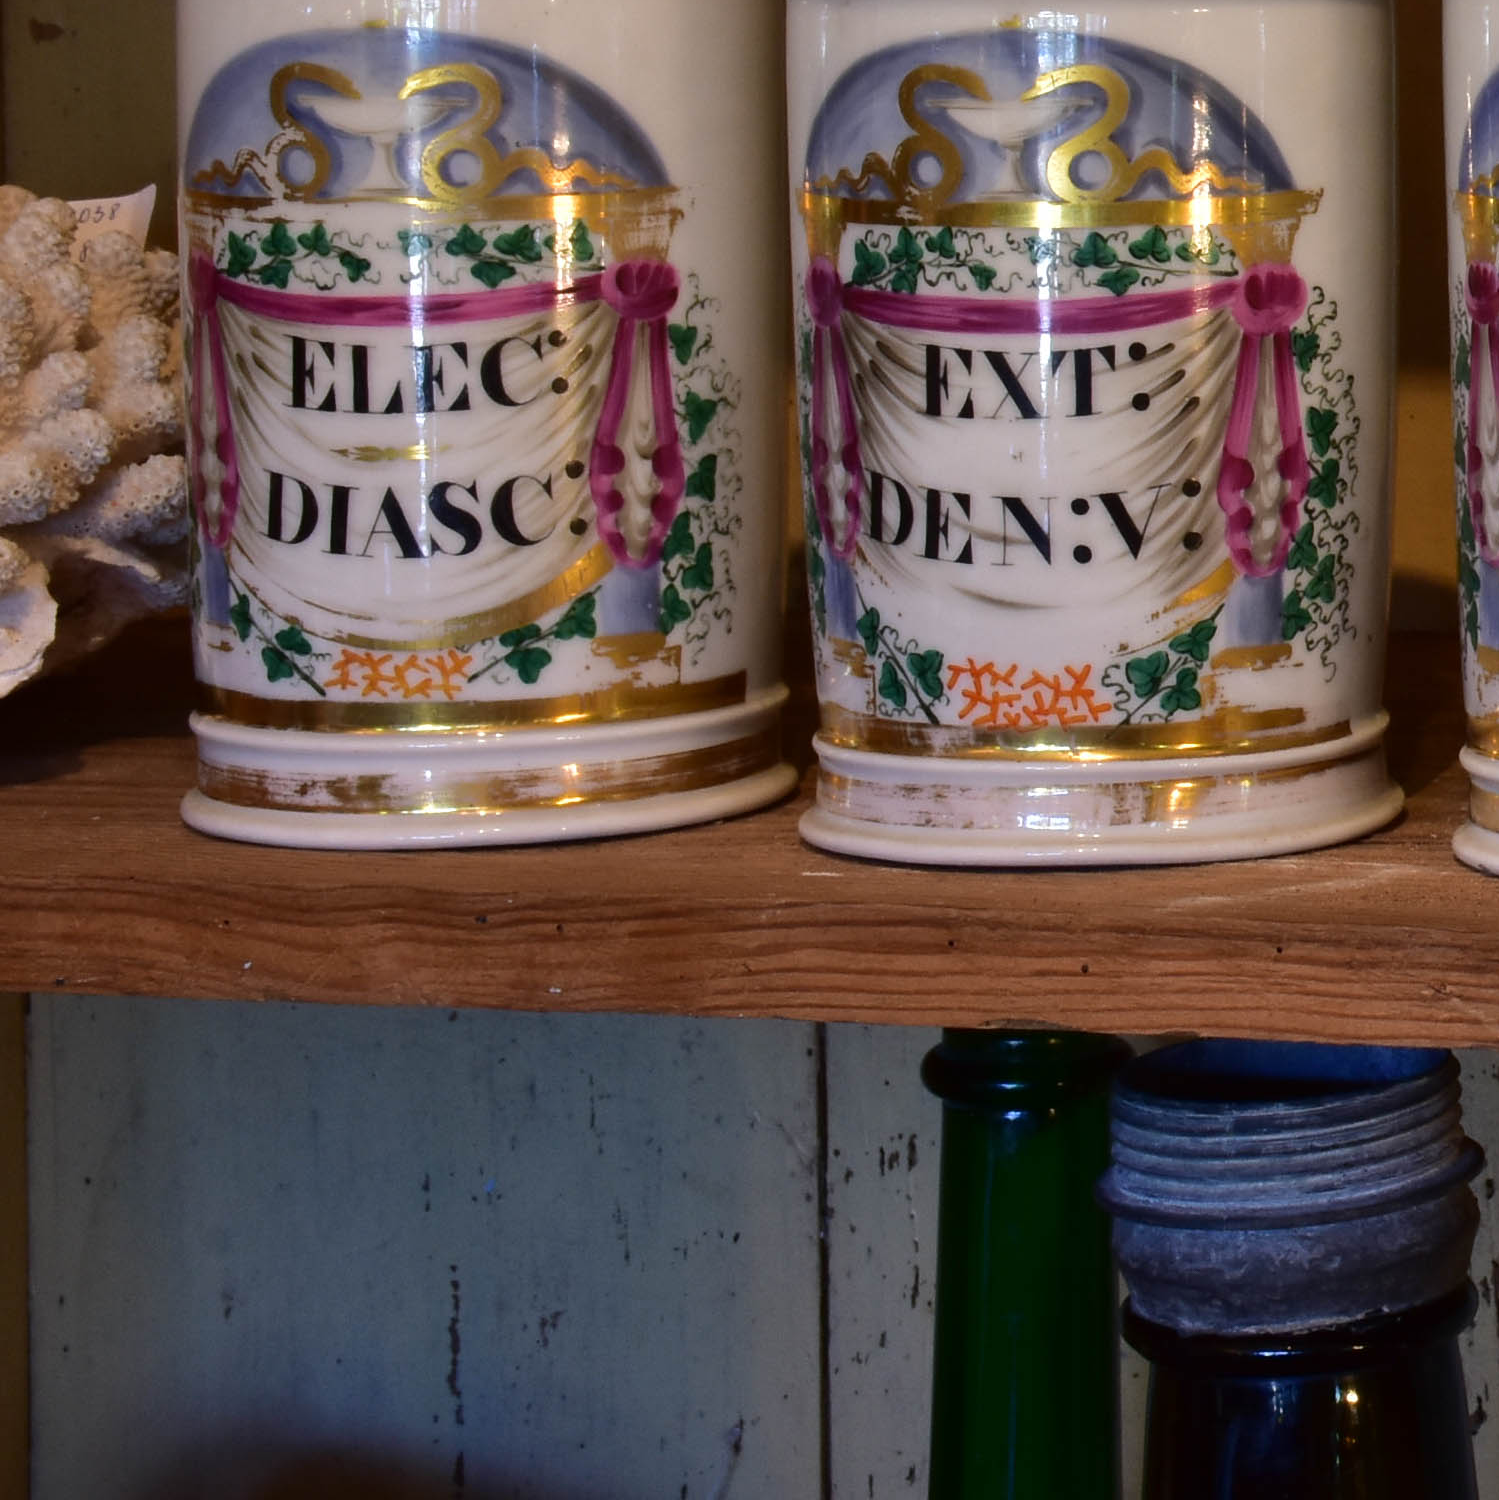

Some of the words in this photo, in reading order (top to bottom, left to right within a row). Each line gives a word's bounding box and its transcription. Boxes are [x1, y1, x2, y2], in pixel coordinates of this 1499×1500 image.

[283, 330, 569, 413] ELEC:
[919, 342, 1151, 420] EXT:
[259, 458, 588, 559] DIASC:
